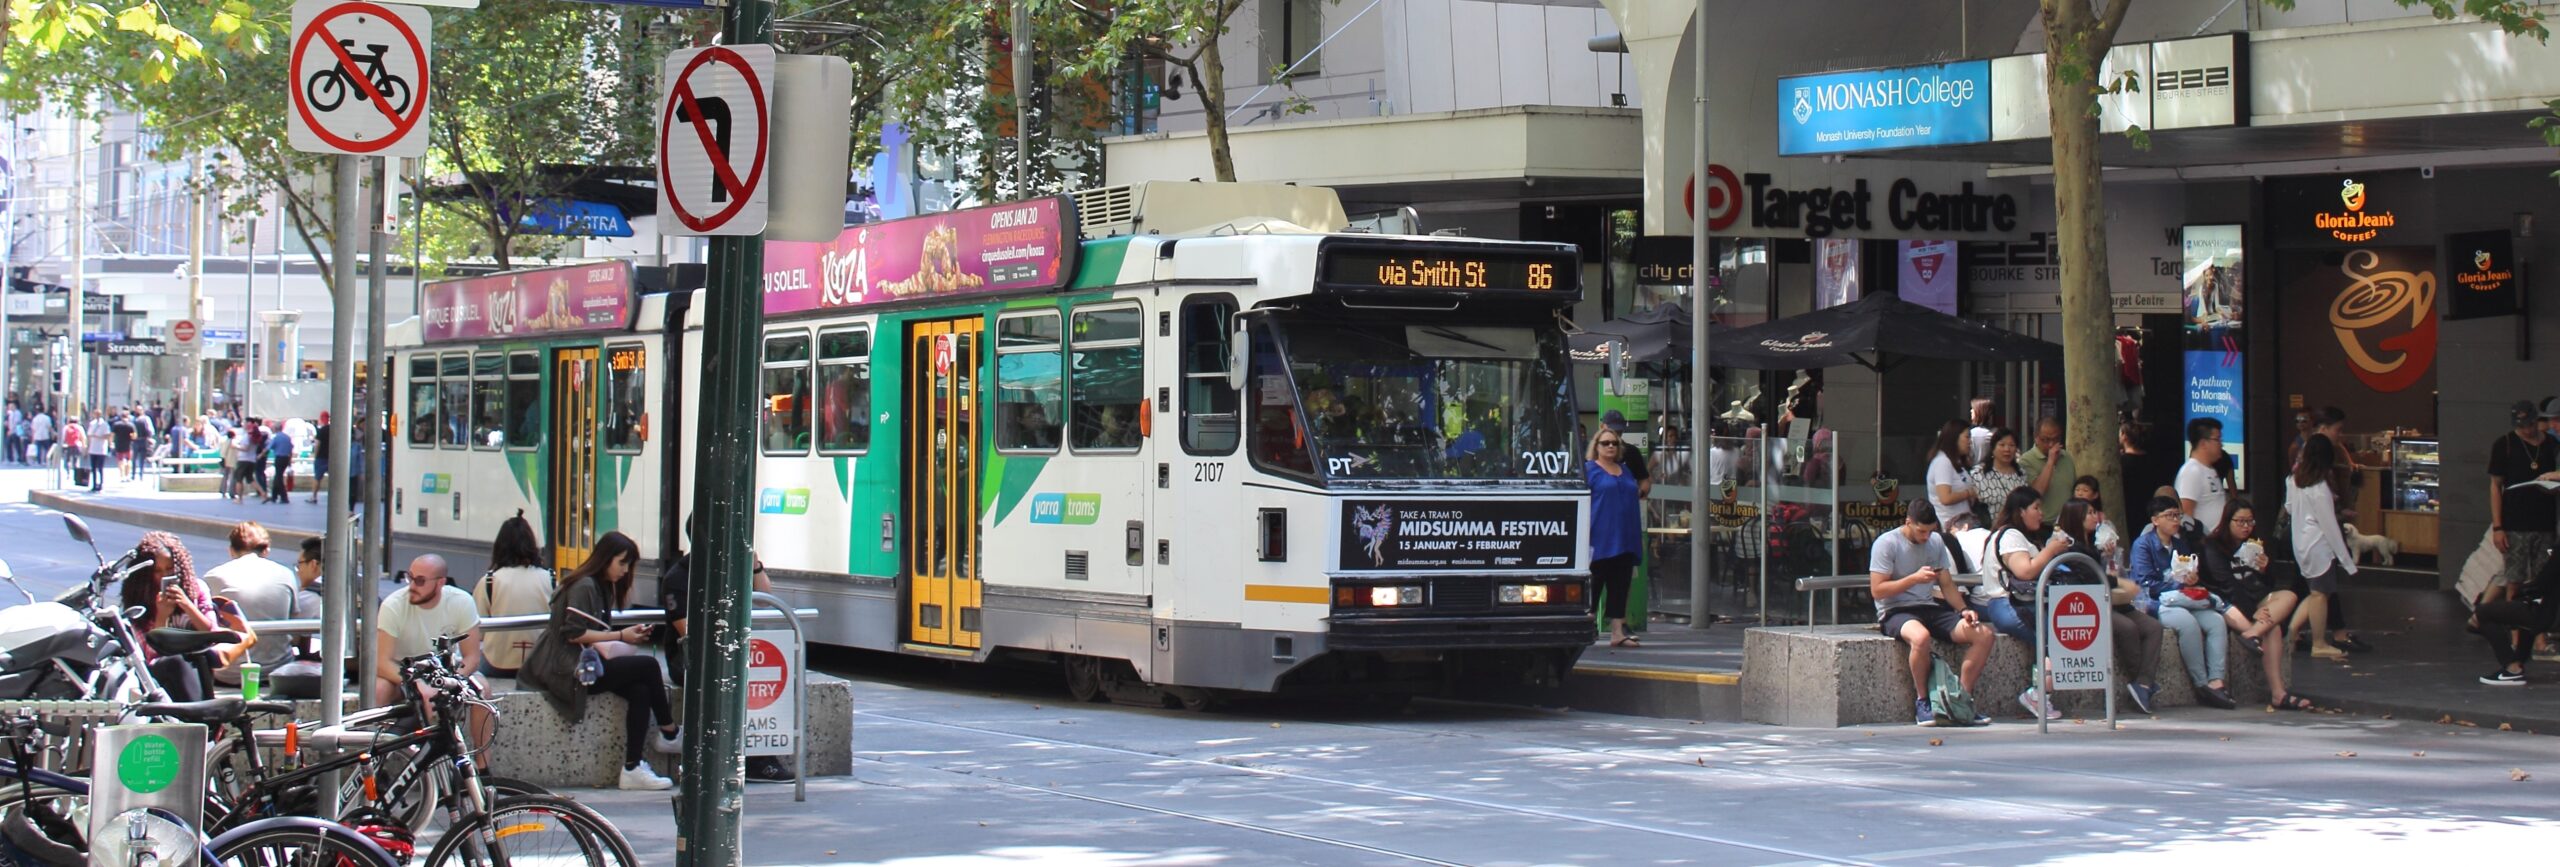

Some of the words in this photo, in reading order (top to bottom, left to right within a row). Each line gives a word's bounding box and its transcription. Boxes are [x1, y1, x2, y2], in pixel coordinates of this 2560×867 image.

[2157, 66, 2229, 91] 222
[1816, 79, 1903, 112] MONASH
[1905, 75, 1974, 108] College
[2156, 89, 2191, 100] BOURKE
[2197, 86, 2229, 97] STREET
[1816, 131, 1843, 143] Monash
[1844, 128, 1875, 141] University
[1877, 126, 1914, 139] Foundation
[1915, 124, 1932, 136] Year
[1744, 173, 1871, 238] Target
[1889, 177, 2017, 232] Centre
[991, 210, 1014, 229] OPENS
[1014, 208, 1028, 226] JAN
[1028, 206, 1038, 225] 20
[2315, 212, 2357, 229] Gloria
[2357, 211, 2395, 228] Jean's
[2332, 228, 2377, 242] COFFEES
[982, 243, 1045, 265] cirquedusoleil.com/kooza
[1969, 232, 2058, 265] 22
[1379, 259, 1407, 286] via
[1411, 259, 1460, 287] Smith
[1465, 261, 1487, 287] St
[1528, 263, 1553, 289] 86
[1640, 264, 1672, 281] city
[1678, 263, 1716, 279] chc
[1969, 267, 2025, 281] BOURKE
[2034, 267, 2060, 281] STR
[2150, 256, 2183, 281] Targ
[763, 272, 773, 293] U
[2457, 271, 2486, 284] Gloria
[2470, 281, 2501, 291] COFFEES
[2135, 294, 2165, 306] Centre
[107, 342, 165, 354] Strandbags
[2191, 376, 2198, 386] A
[2198, 375, 2233, 389] pathway
[2191, 390, 2200, 399] to
[2201, 389, 2231, 400] Monash
[2191, 402, 2229, 415] University
[1328, 457, 1351, 475] PT
[1522, 451, 1570, 475] 2107
[1194, 462, 1224, 482] 2107
[1035, 499, 1059, 519] yarra
[1068, 499, 1096, 516] trams
[1400, 510, 1418, 519] TAKE
[1420, 510, 1427, 519] A
[1429, 510, 1449, 519] TRAM
[1451, 510, 1463, 519] TO
[1710, 502, 1732, 515] loria
[1845, 502, 1890, 517] Gloria
[1399, 521, 1496, 536] MIDSUMMA
[1501, 521, 1568, 536] FESTIVAL
[1399, 541, 1410, 550] 15
[1413, 541, 1458, 550] JANUARY
[1467, 541, 1473, 550] 5
[1475, 541, 1521, 550] FEBRUARY
[1397, 558, 1447, 566] midsumma.org.au
[2069, 602, 2084, 613] NO
[2060, 629, 2093, 640] ENTRY
[2061, 657, 2095, 668] TRAMS
[2055, 671, 2104, 683] EXCEPTED
[748, 684, 777, 697] TRY
[747, 717, 777, 730] AMS
[745, 735, 789, 747] EPTED
